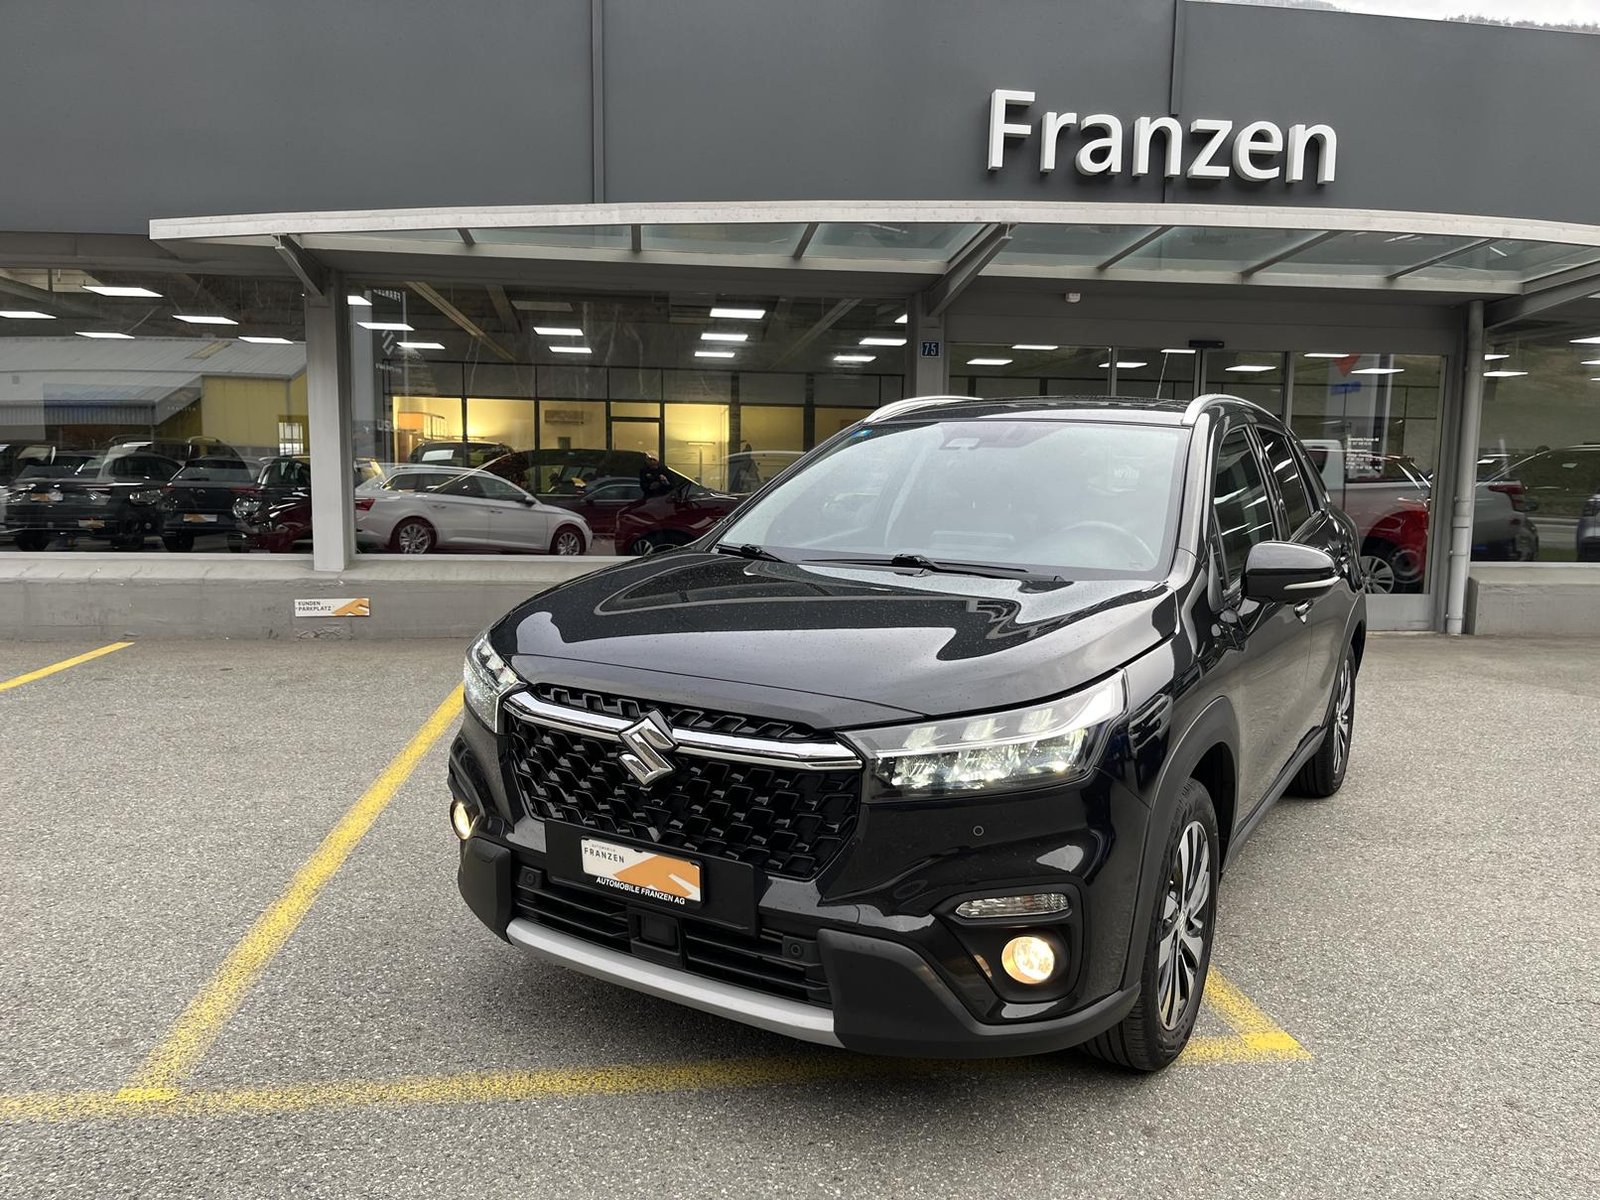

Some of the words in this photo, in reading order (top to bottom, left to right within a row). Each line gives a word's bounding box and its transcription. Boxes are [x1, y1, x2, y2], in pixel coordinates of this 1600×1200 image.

[987, 88, 1337, 185] Franzen
[924, 343, 937, 356] 75
[584, 847, 625, 863] FRANZEN
[596, 876, 640, 894] AUTOMOBILE
[640, 889, 674, 902] FRANZEN
[674, 896, 686, 905] AG
